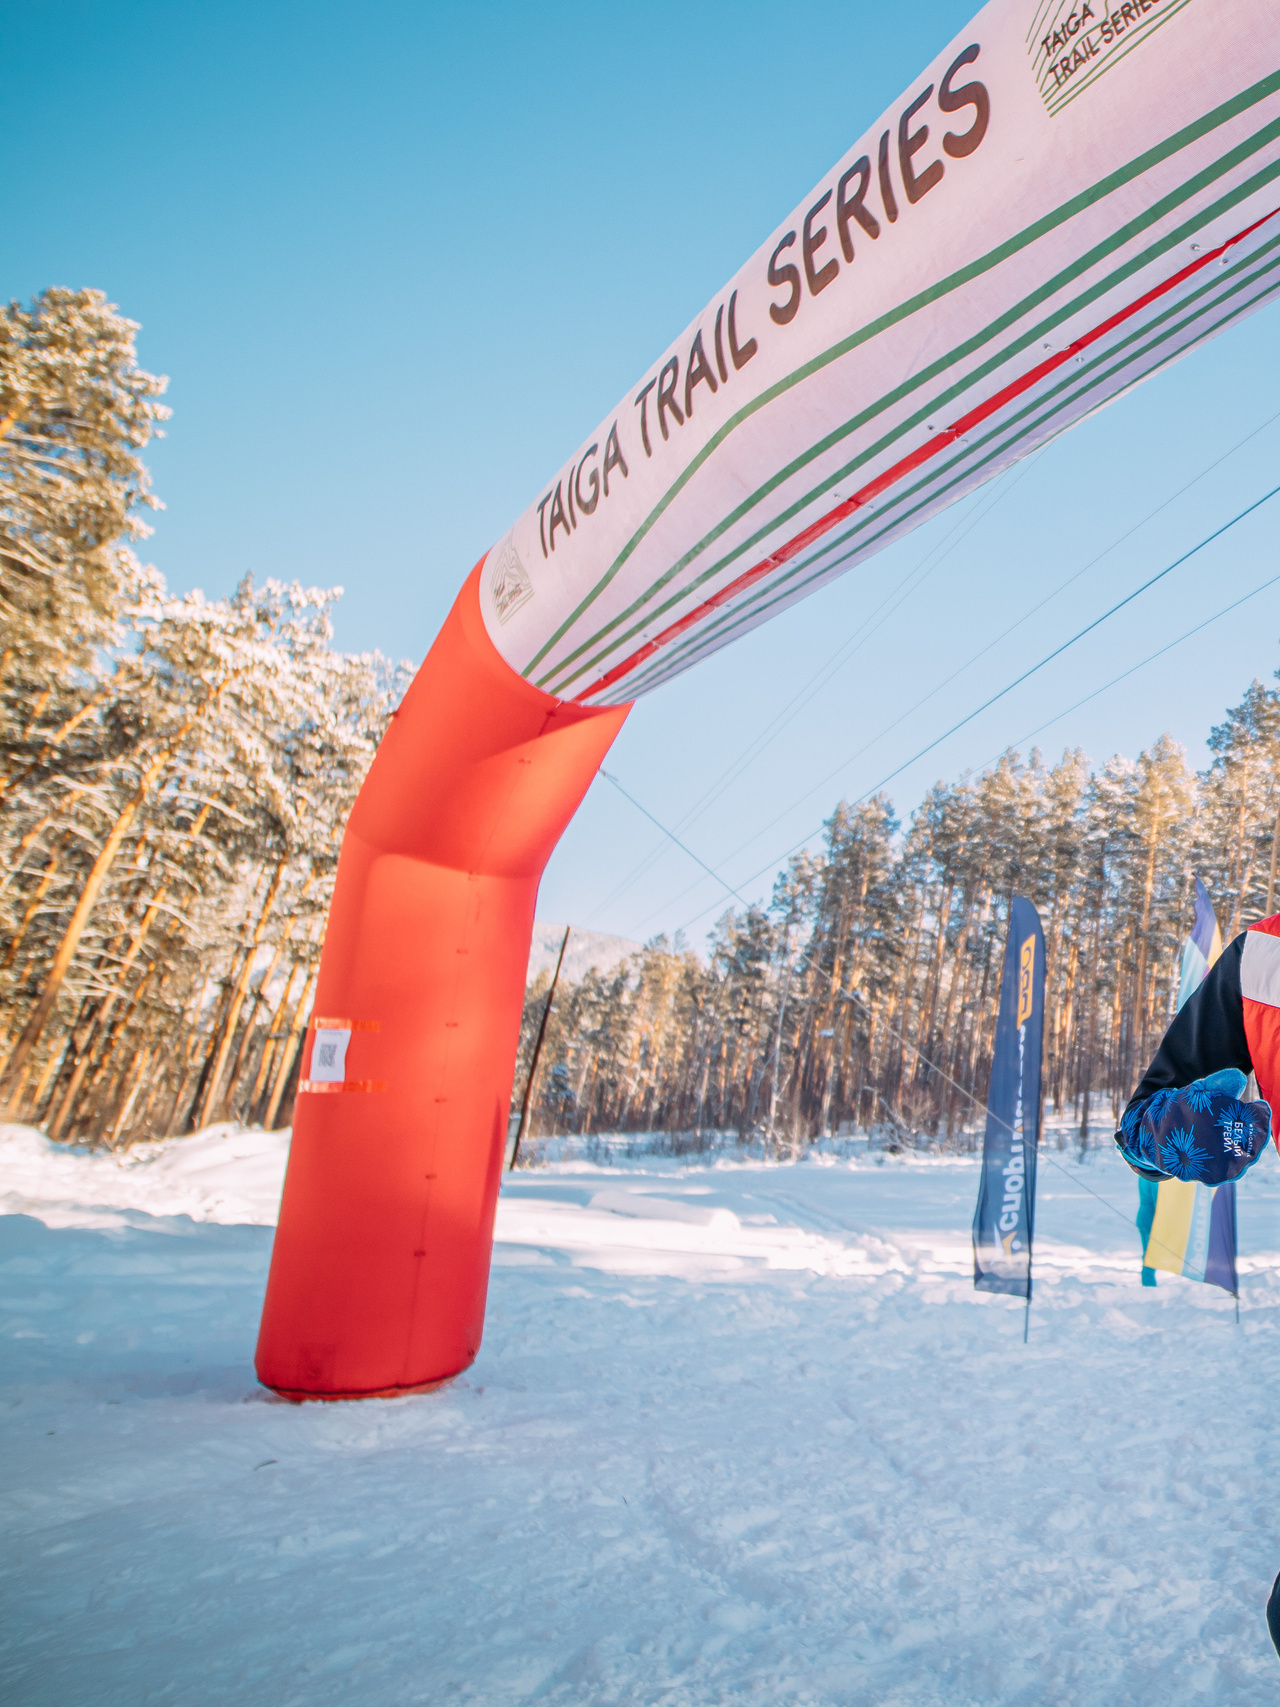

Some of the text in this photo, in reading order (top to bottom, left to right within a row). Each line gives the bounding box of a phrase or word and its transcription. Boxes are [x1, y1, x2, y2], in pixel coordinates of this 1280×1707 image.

[1041, 2, 1094, 57] TAIGA
[1049, 0, 1160, 86] TRAIL SERIE
[536, 43, 990, 559] TAIGA TRAIL SERIES
[1223, 1120, 1233, 1153] ТРЕЙЛ
[1233, 1121, 1243, 1157] БЕЛЫЙ
